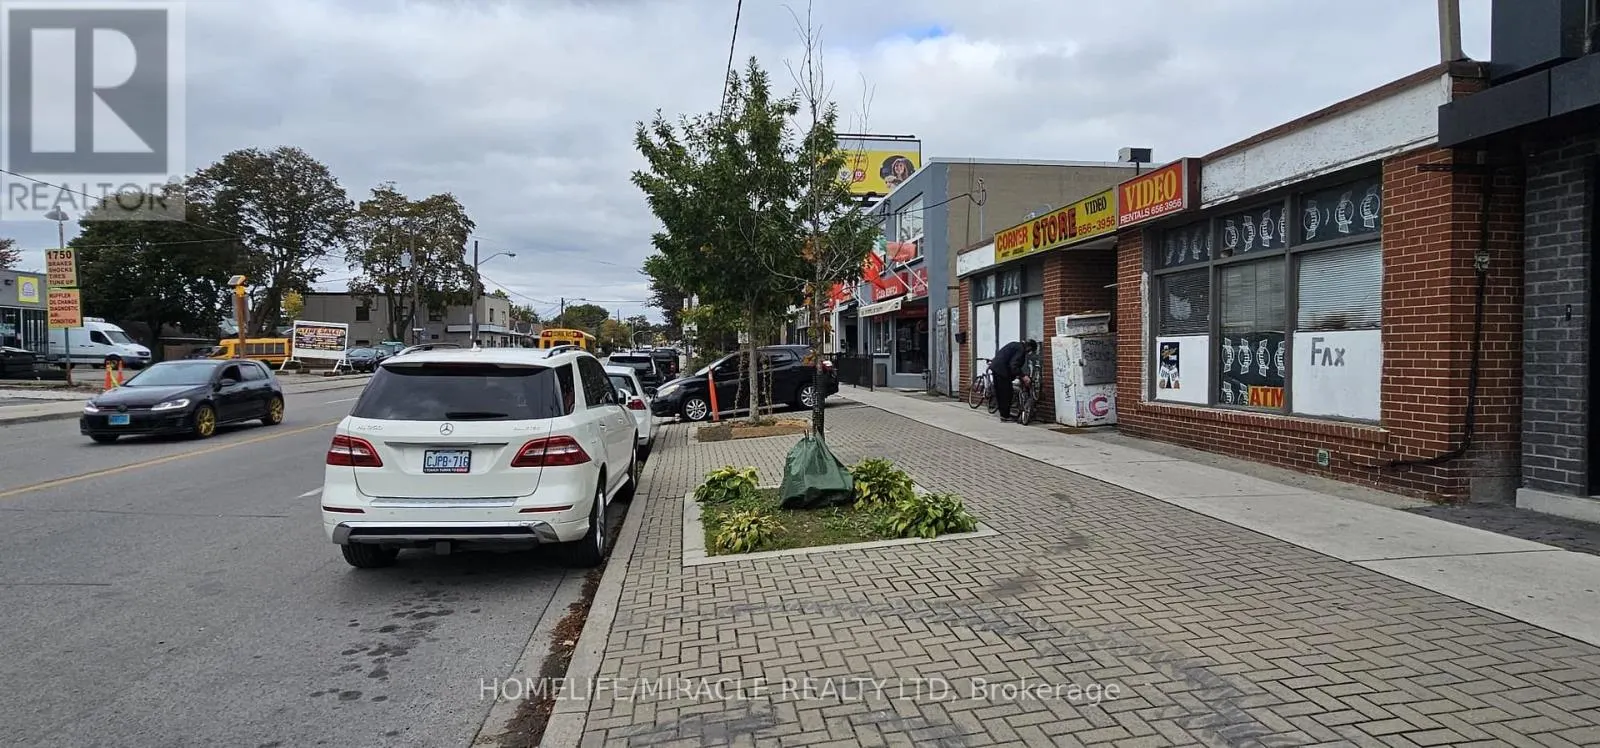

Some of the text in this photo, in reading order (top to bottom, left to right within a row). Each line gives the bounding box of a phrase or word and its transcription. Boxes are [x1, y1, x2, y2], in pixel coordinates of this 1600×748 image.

[1124, 170, 1177, 212] VIDEO
[1084, 196, 1107, 216] VIDEO
[1078, 216, 1115, 235] 656-3956
[1120, 208, 1150, 224] RENTALS
[996, 208, 1077, 251] CORNER STORE
[48, 250, 72, 260] 1750
